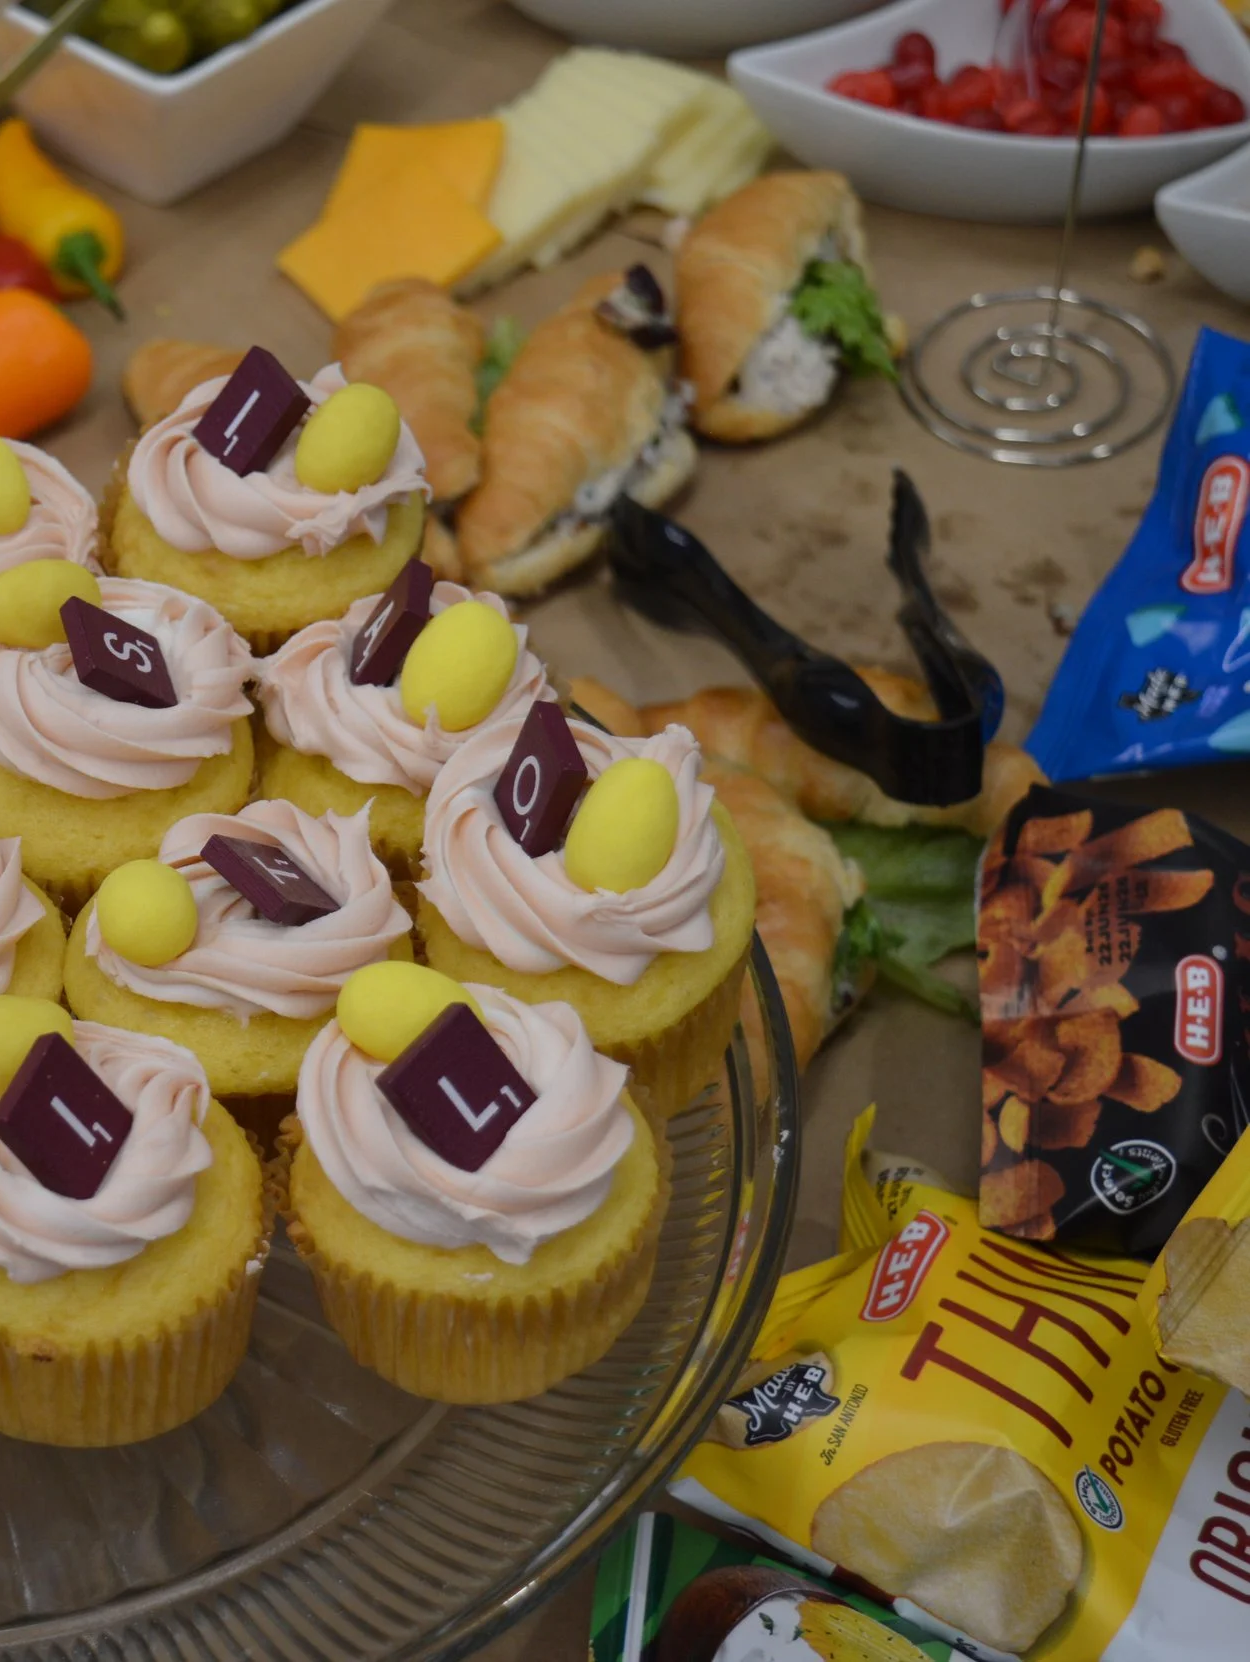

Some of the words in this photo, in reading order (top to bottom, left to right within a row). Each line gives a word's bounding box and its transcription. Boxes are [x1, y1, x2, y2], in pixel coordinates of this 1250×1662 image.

[827, 1425, 847, 1448] SAN
[839, 1383, 869, 1427] ANTONIO
[1098, 1370, 1166, 1486] POTATO
[1160, 1410, 1190, 1447] GLUTEN
[1179, 1388, 1204, 1417] FREE
